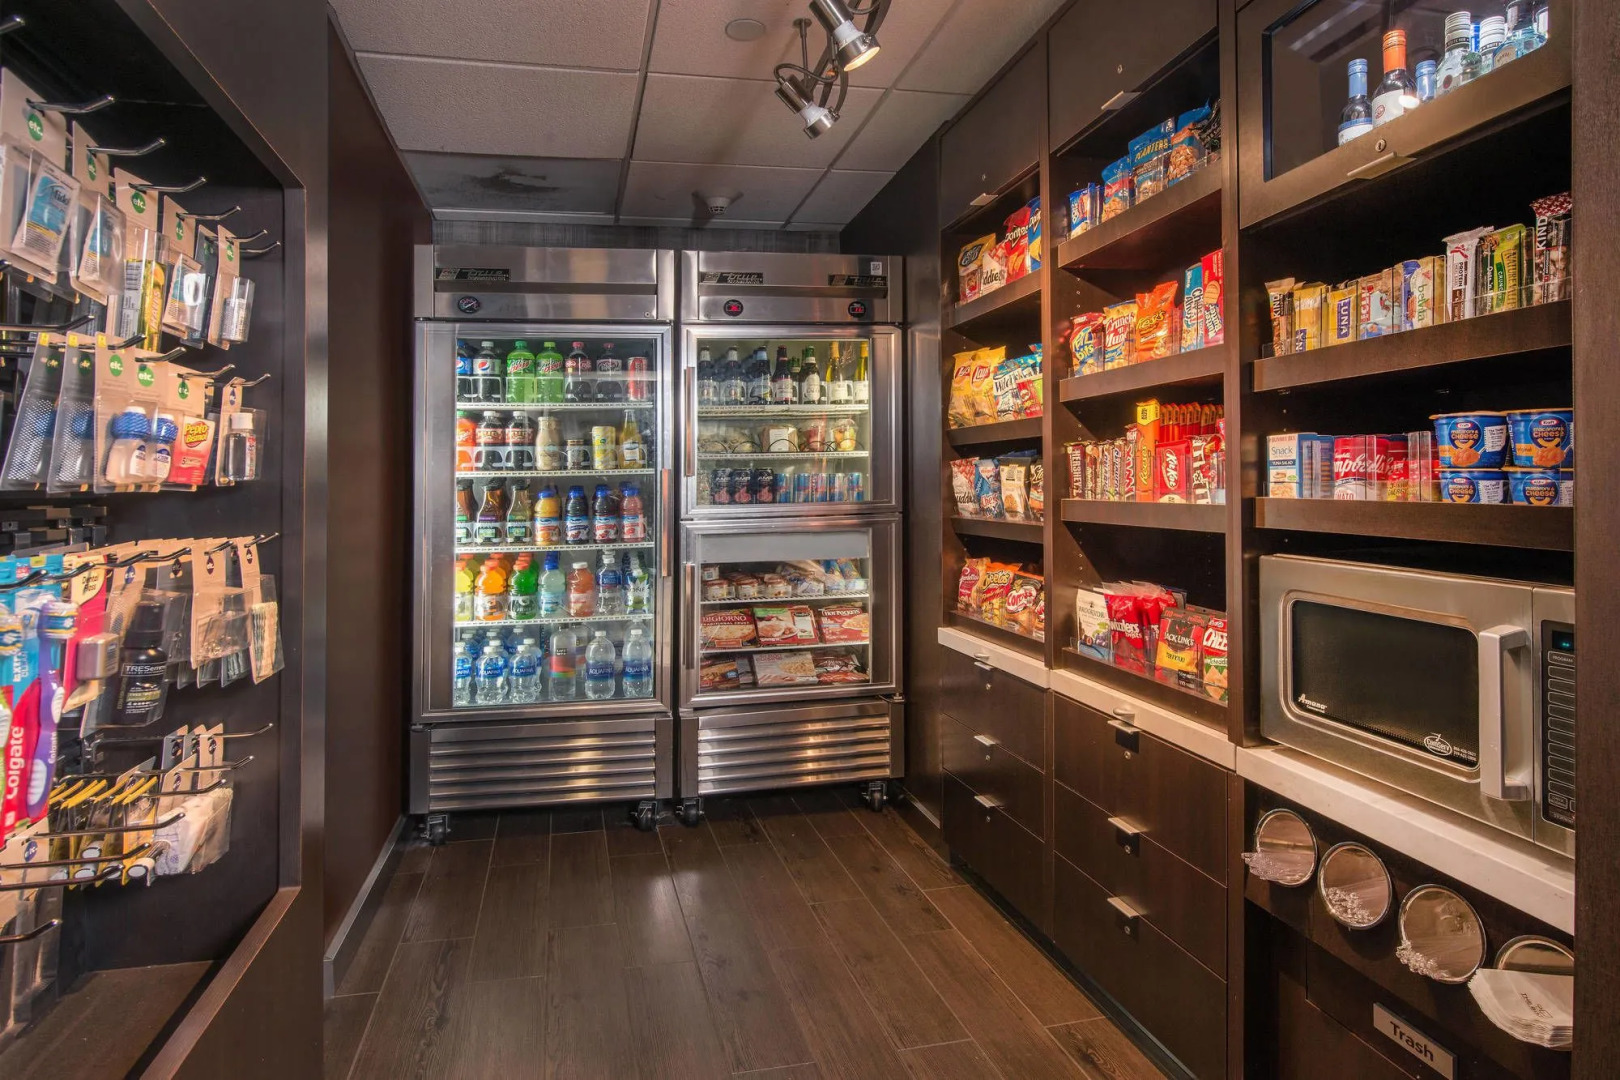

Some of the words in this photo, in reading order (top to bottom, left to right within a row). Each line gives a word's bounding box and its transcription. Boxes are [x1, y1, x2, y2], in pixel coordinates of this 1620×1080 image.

[1537, 216, 1548, 250] KIND
[1273, 293, 1281, 318] KIND
[1340, 298, 1350, 335] LUNA
[1417, 283, 1428, 322] belvita
[110, 361, 123, 371] etc.
[138, 372, 154, 382] etc.
[184, 422, 209, 434] Pepto
[1271, 447, 1293, 456] Snack
[1298, 693, 1328, 710] Amana
[48, 731, 57, 765] Colgate
[6, 726, 25, 800] Colgate
[1389, 1020, 1434, 1062] Trash
